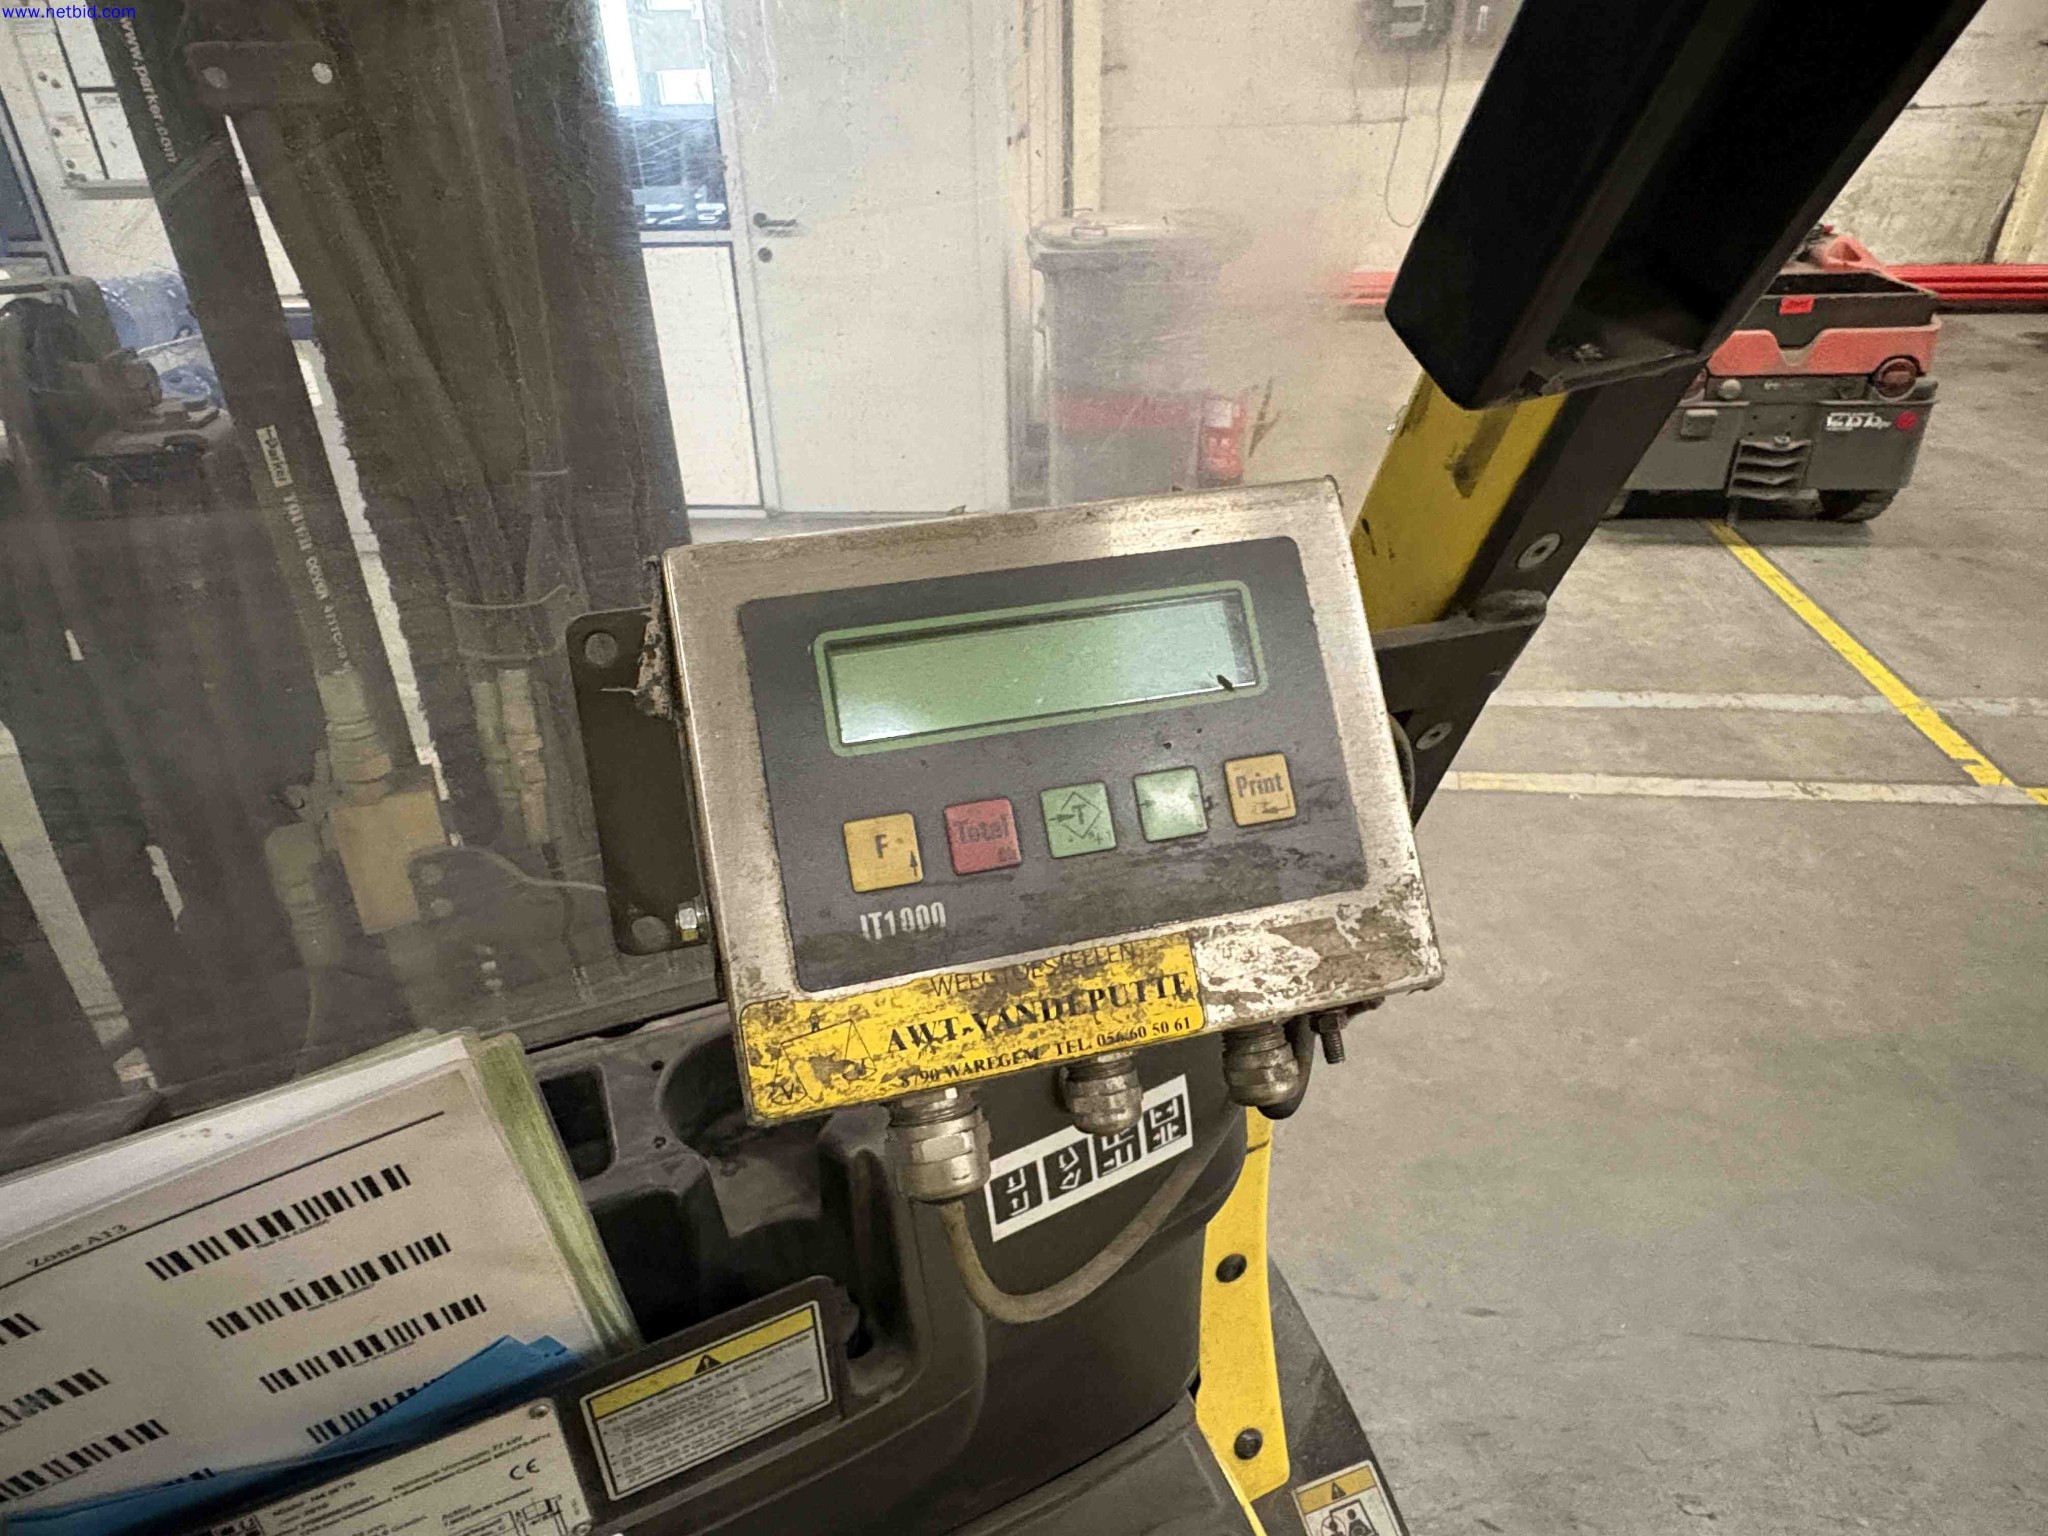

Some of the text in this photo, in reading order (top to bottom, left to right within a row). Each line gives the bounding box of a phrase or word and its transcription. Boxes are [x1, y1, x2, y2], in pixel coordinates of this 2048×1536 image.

[1236, 772, 1284, 799] Print
[874, 833, 889, 860] F
[953, 813, 1011, 845] Total
[859, 902, 947, 941] IT1000
[887, 971, 1190, 1056] AWT-VANDEPUTTE
[942, 1043, 1042, 1080] WAREGEM
[1055, 1036, 1093, 1056] TEL.
[1151, 1021, 1170, 1038] 50
[1173, 1016, 1192, 1033] 61
